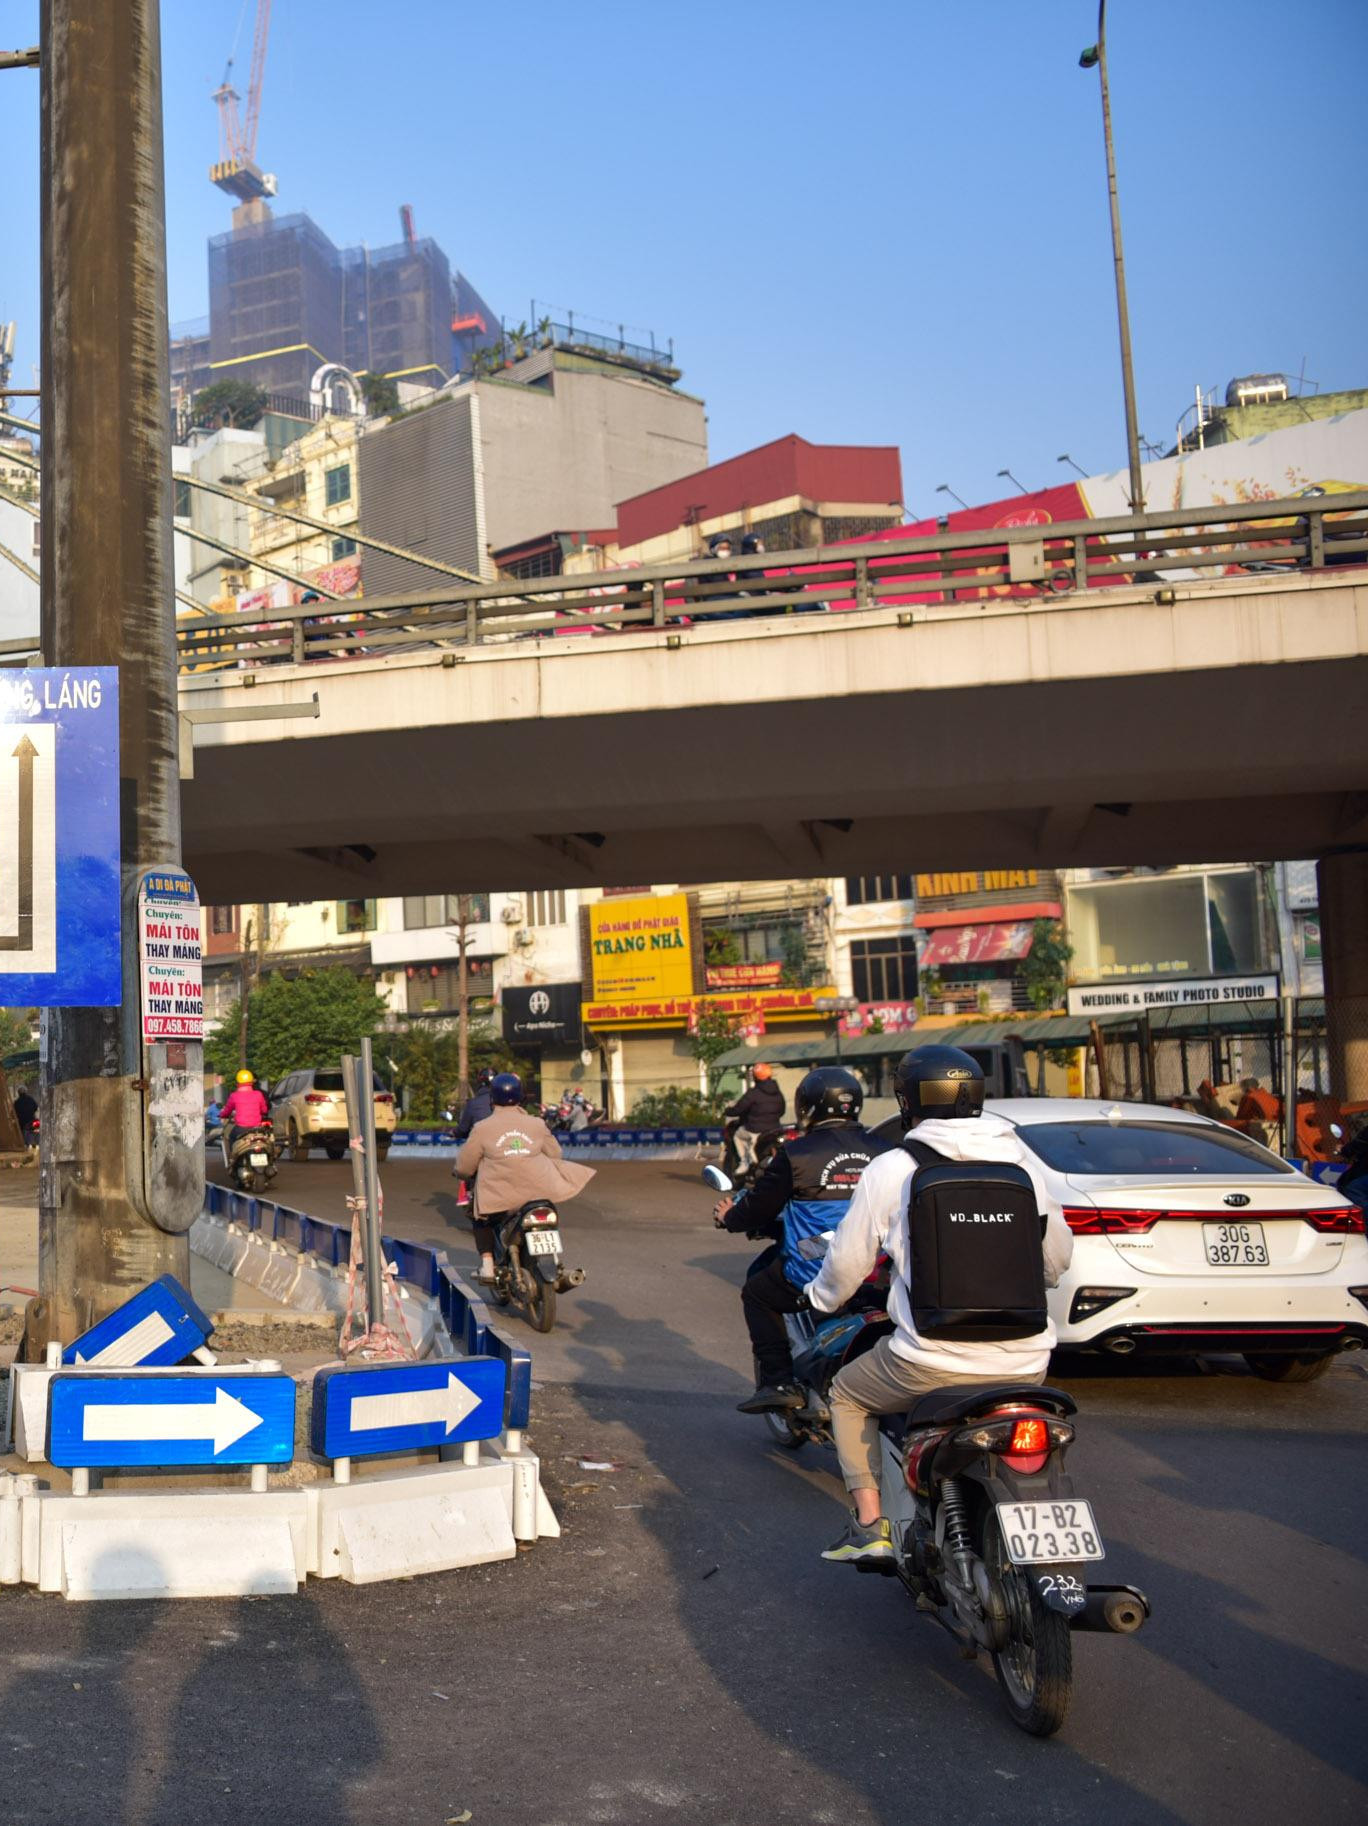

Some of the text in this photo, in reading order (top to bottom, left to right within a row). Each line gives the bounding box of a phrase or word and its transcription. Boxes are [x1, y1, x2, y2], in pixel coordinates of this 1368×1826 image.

[44, 672, 102, 709] LÁNG
[145, 908, 183, 920] Chuyên:
[146, 922, 199, 941] MÁI TÔN
[146, 943, 201, 960] THAY MÁNG
[594, 935, 645, 955] TRANG
[148, 966, 185, 977] Chuyên:
[149, 979, 201, 997] MÁI TÔN
[1081, 985, 1265, 1007] WEDDING & FAMILY PHOTO STUDIO
[148, 998, 203, 1015] THAY MÁNG
[1226, 1195, 1248, 1205] KIA
[1218, 1225, 1250, 1243] 30G
[1209, 1245, 1266, 1263] 387.63
[1013, 1505, 1082, 1530] 17-B2
[1011, 1532, 1097, 1558] 023.38
[1039, 1575, 1083, 1596] 232
